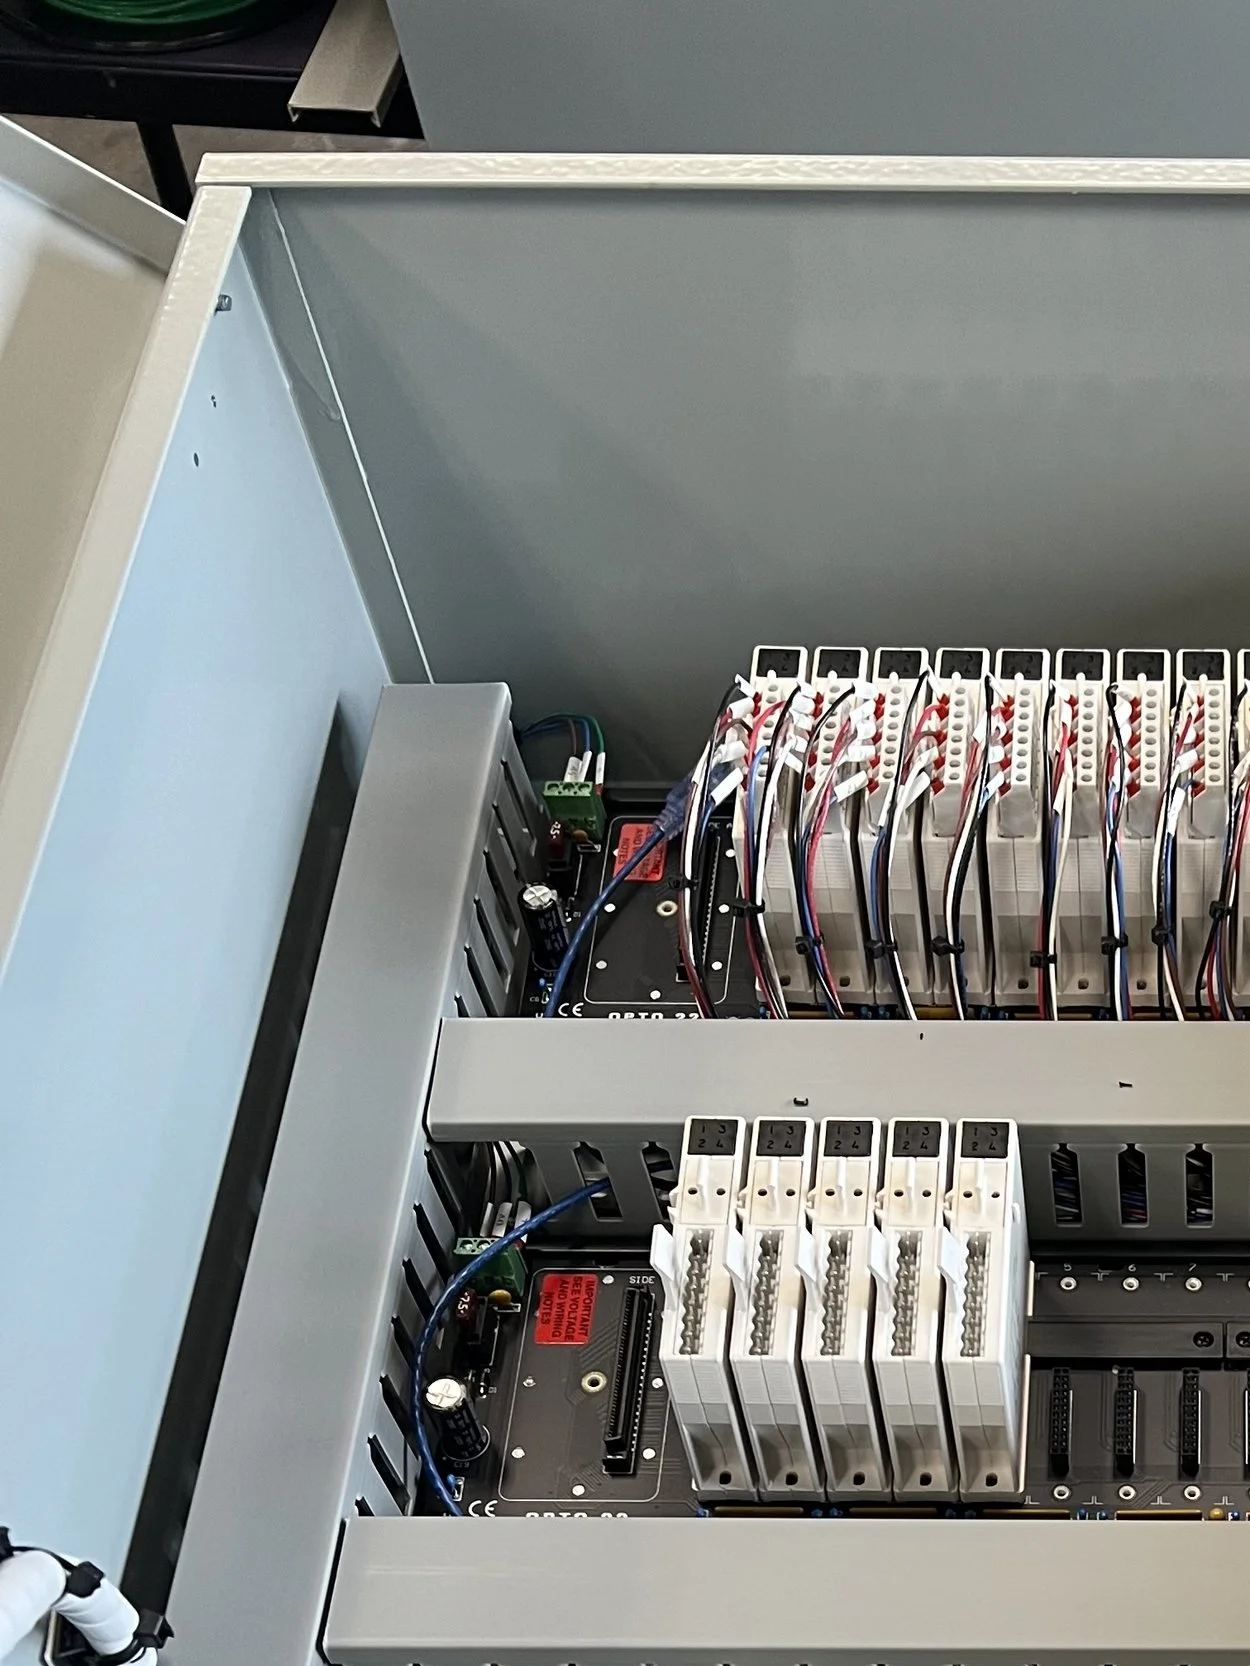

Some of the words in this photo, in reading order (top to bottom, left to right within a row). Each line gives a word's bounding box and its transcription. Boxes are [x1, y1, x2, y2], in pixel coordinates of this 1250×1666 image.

[558, 1002, 584, 1017] CE
[1063, 1264, 1072, 1272] 5
[1128, 1264, 1137, 1272] 6
[1188, 1264, 1197, 1272] 7
[558, 1279, 569, 1300] AND
[571, 1276, 583, 1296] SEE
[629, 1275, 656, 1284] SIDE
[541, 1291, 554, 1325] NOTES
[579, 1280, 596, 1337] IMPORTANT
[551, 1301, 567, 1338] WIRING
[564, 1296, 579, 1341] VOLTAGE
[468, 1500, 498, 1518] CE
